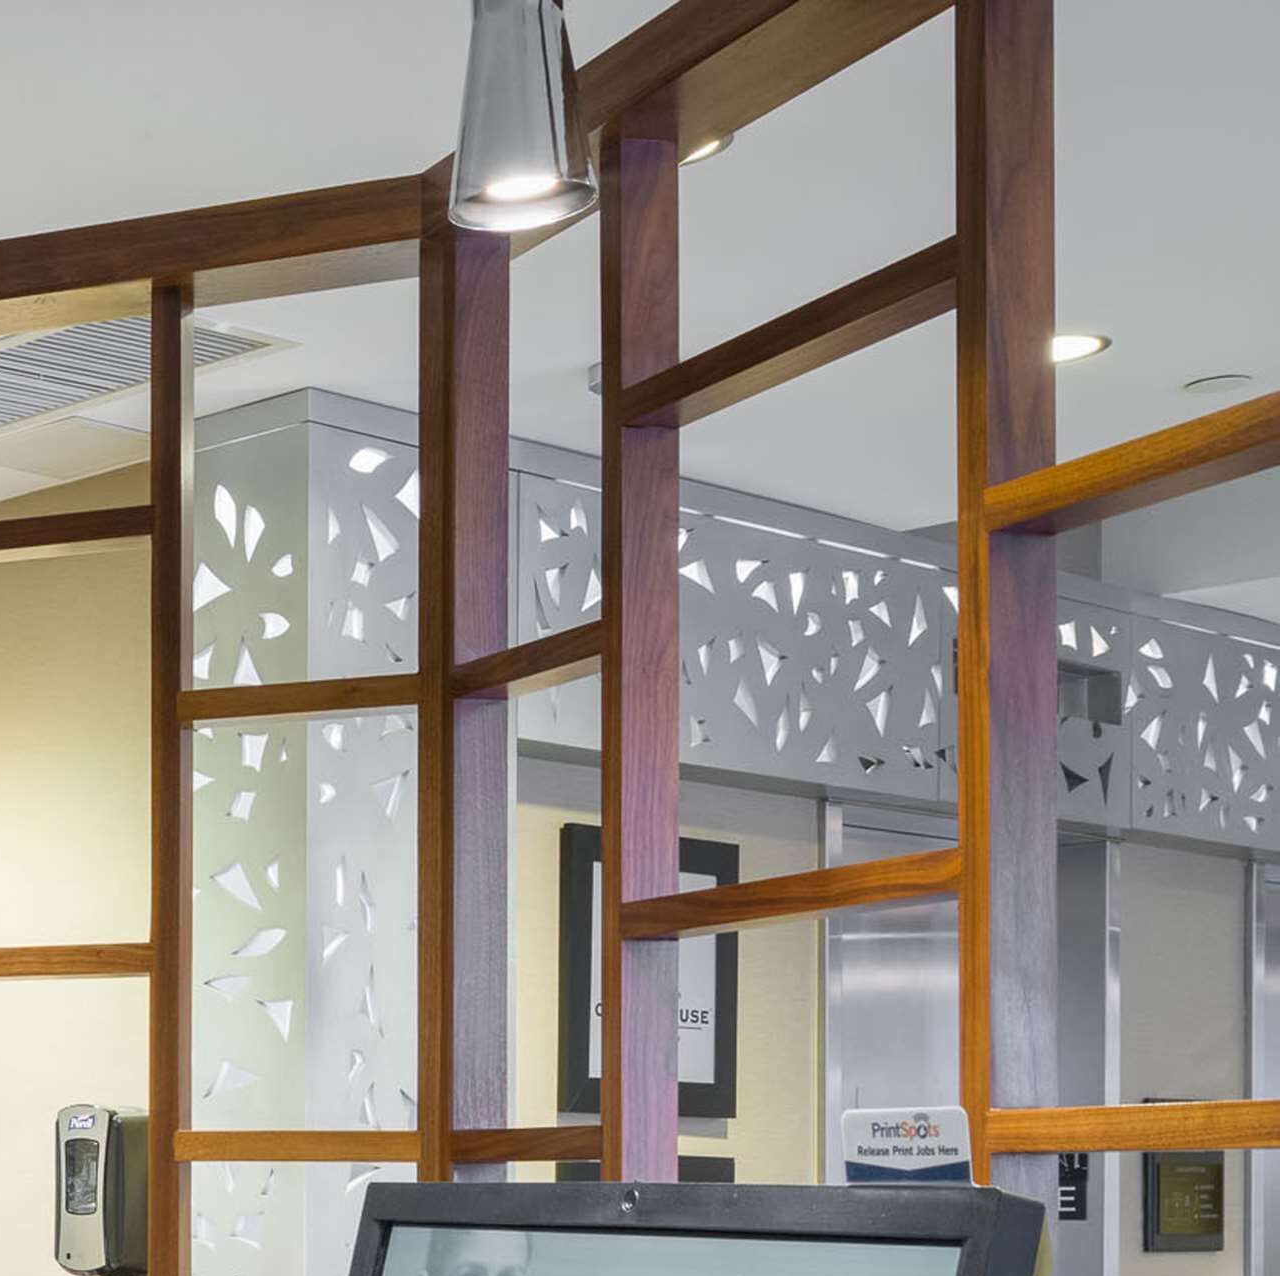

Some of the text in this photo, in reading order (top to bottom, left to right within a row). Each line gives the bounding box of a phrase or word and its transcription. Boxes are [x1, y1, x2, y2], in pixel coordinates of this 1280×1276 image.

[871, 1121, 940, 1141] PrintSpots
[857, 1145, 959, 1156] Release Print Jobs Here
